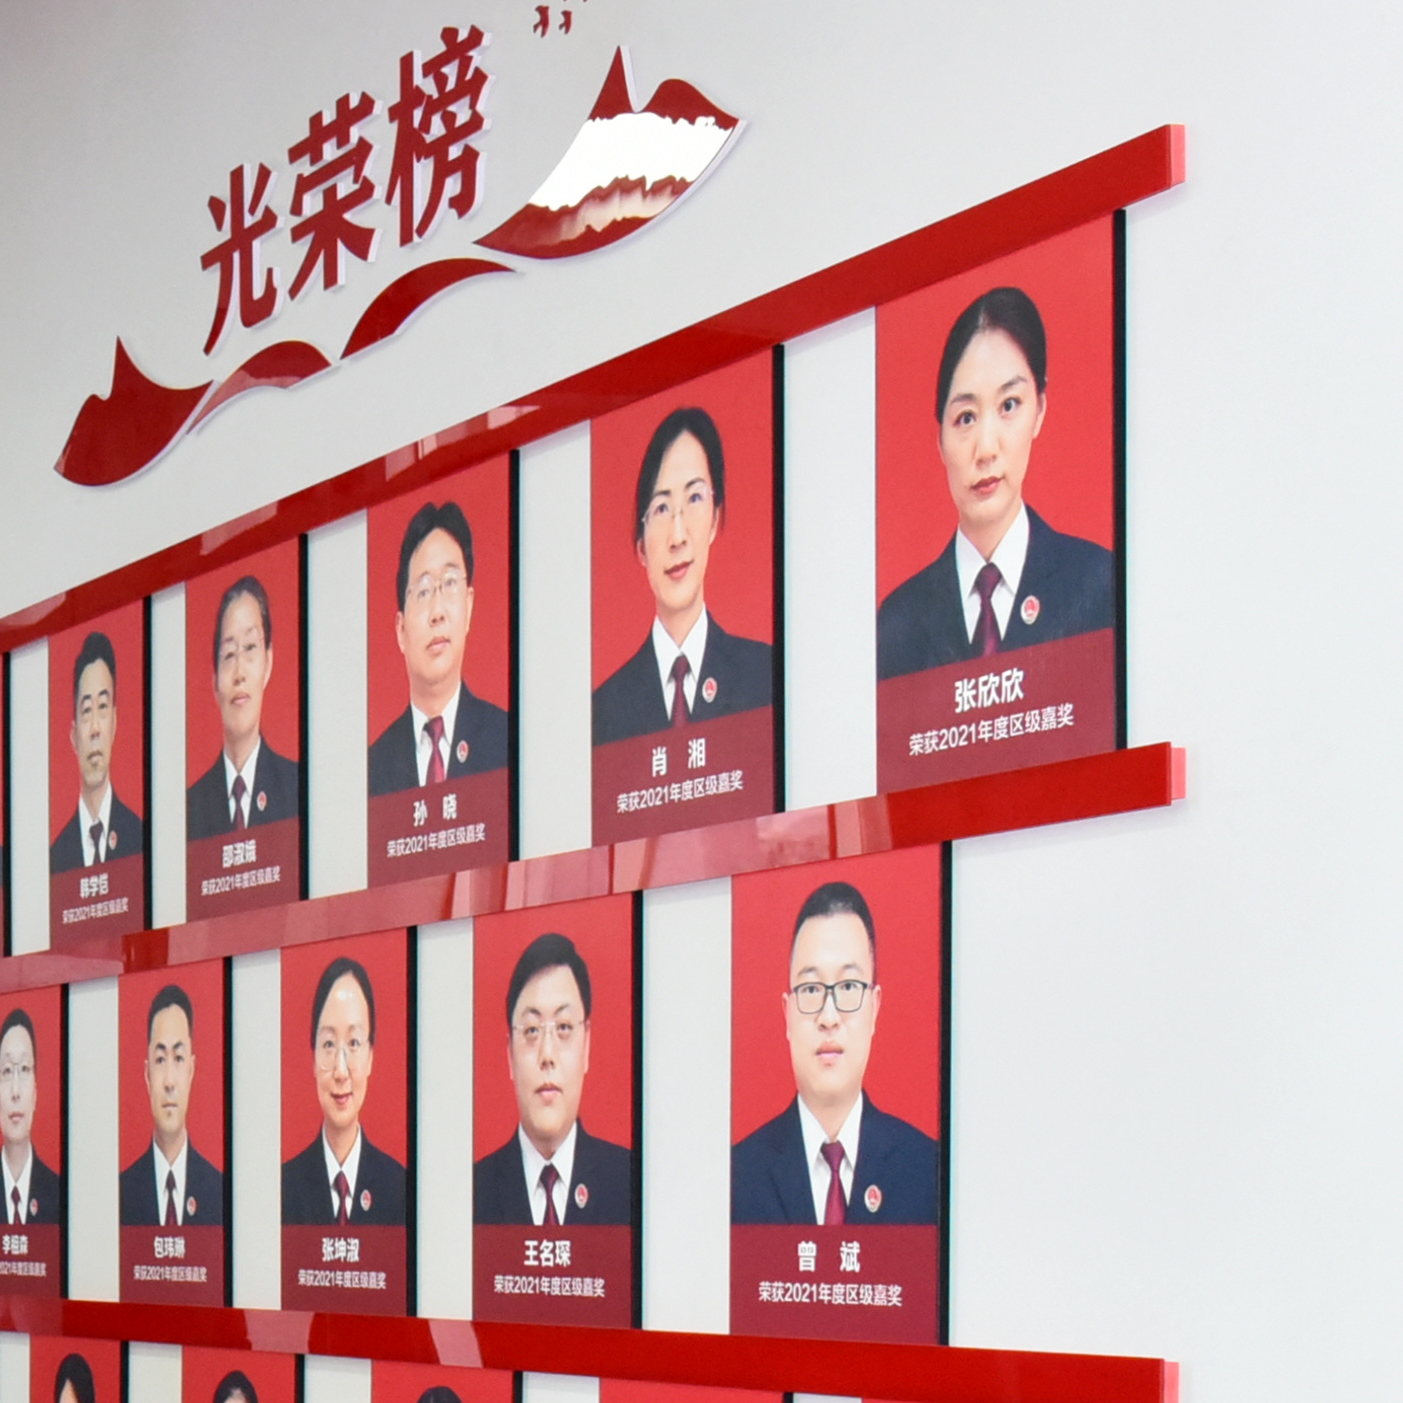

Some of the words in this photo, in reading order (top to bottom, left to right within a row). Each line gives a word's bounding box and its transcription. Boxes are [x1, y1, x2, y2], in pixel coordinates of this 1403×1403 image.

[200, 25, 491, 357] 光荣榜
[954, 667, 1024, 714] 张欣欣
[908, 702, 1074, 757] 荣获2021年度区级嘉奖
[616, 769, 744, 815] 荣获2021年度区级嘉奖
[386, 822, 486, 859] 荣获2021年度区级嘉奖
[524, 1239, 571, 1267] 王名琛
[494, 1274, 605, 1299] 荣获2021年度区级嘉奖
[758, 1280, 903, 1308] 荣获2021年度区级嘉奖
